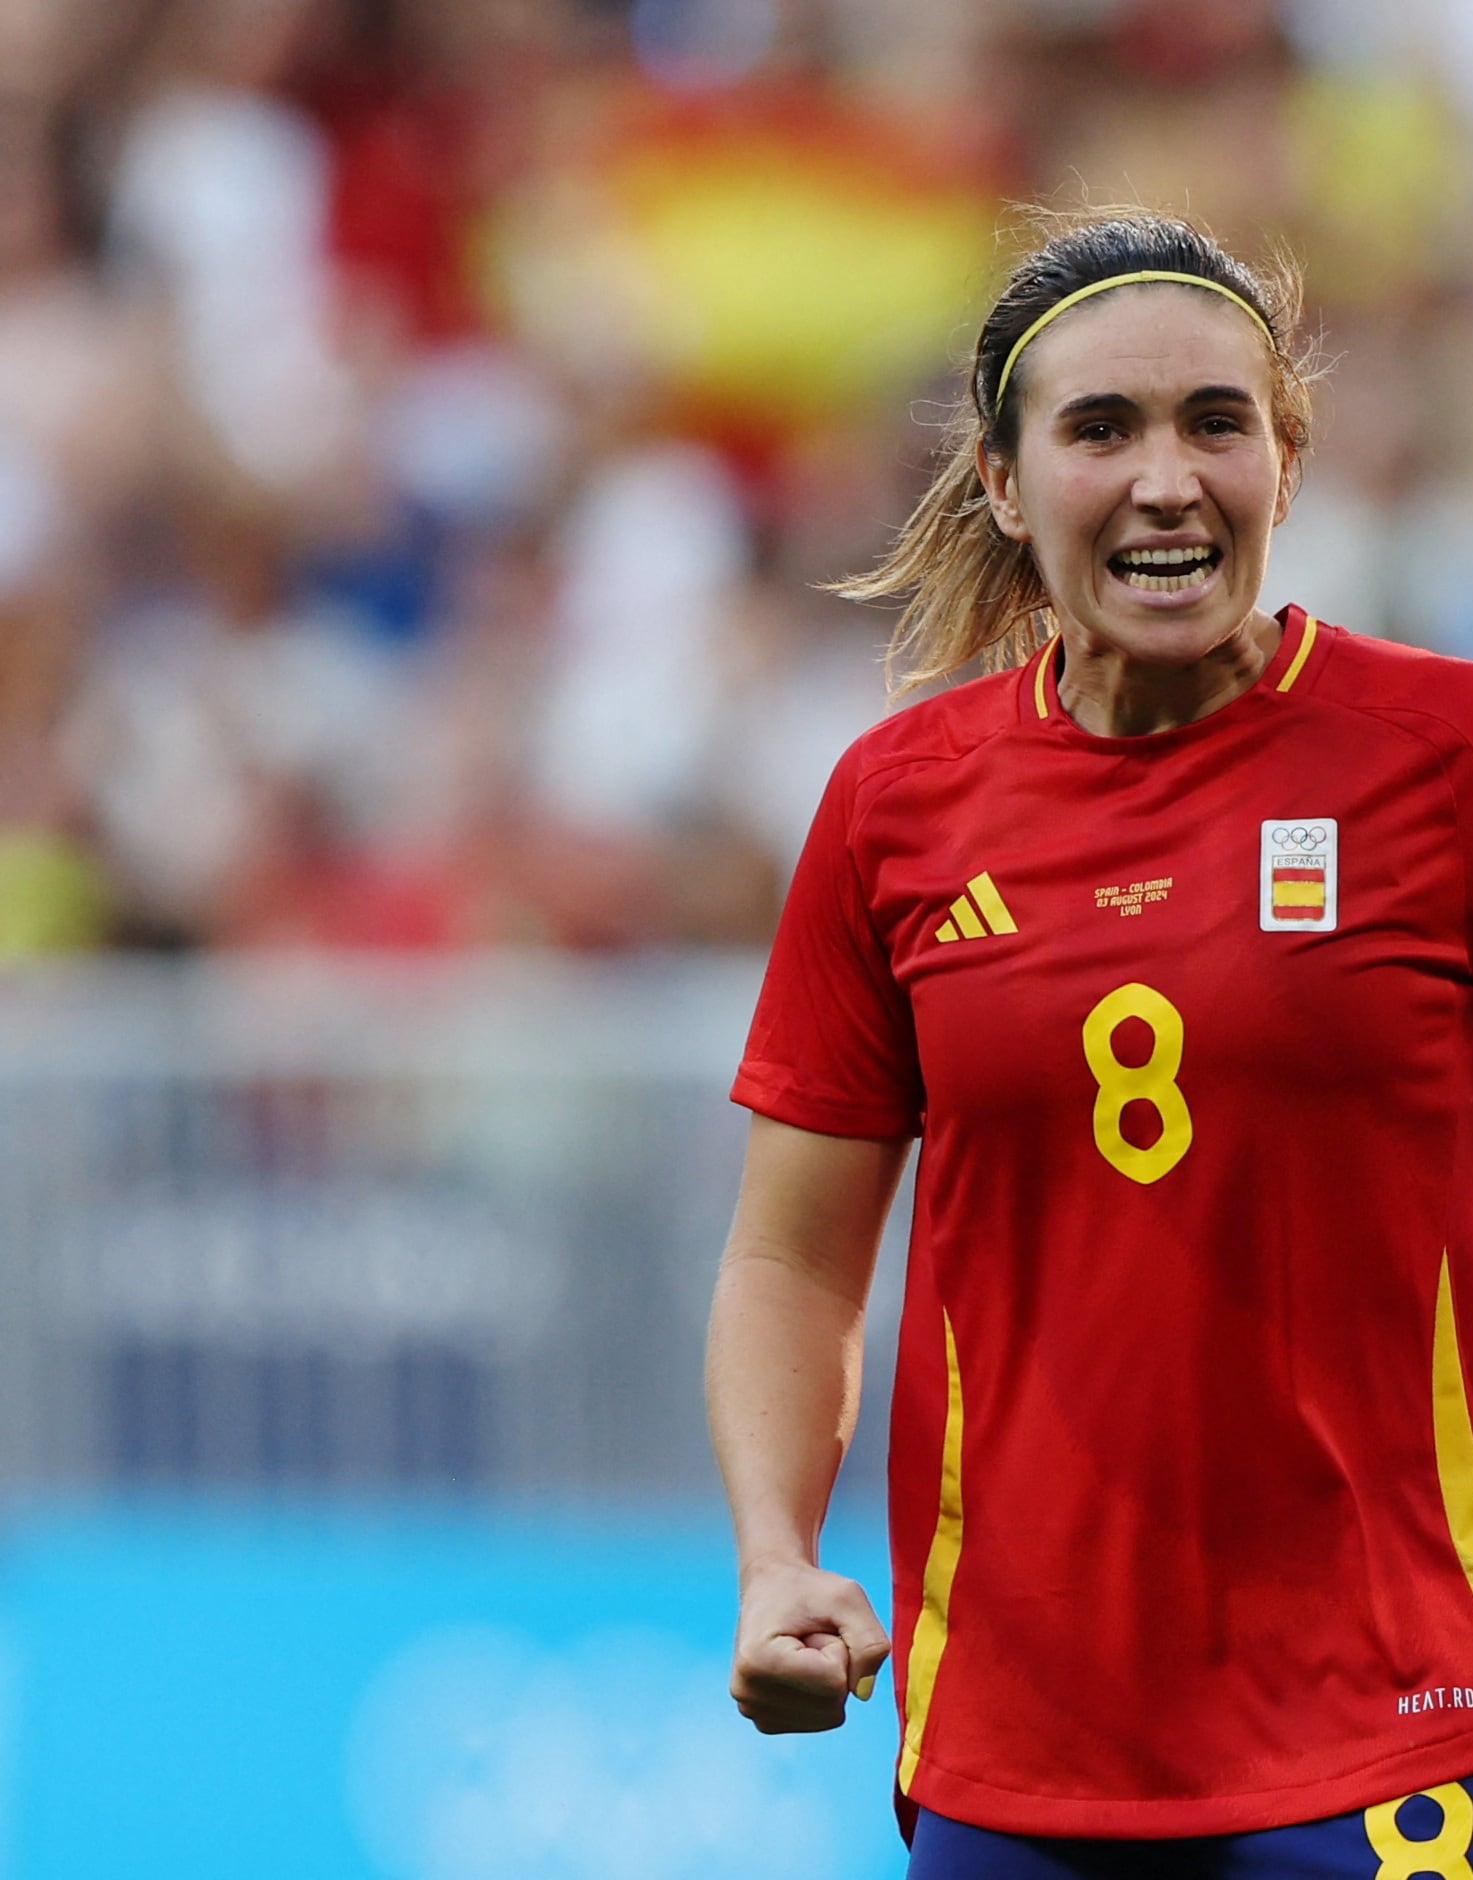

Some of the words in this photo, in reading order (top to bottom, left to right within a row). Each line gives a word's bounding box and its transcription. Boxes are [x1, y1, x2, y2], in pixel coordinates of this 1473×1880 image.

[1277, 856, 1321, 866] ESPAÑA
[1094, 886, 1120, 898] SPAIN
[1128, 877, 1173, 893] COLOMBIA
[1110, 893, 1143, 906] AUGUST
[1144, 890, 1168, 903] 2024
[1120, 904, 1142, 917] LYON
[1082, 982, 1193, 1184] 8
